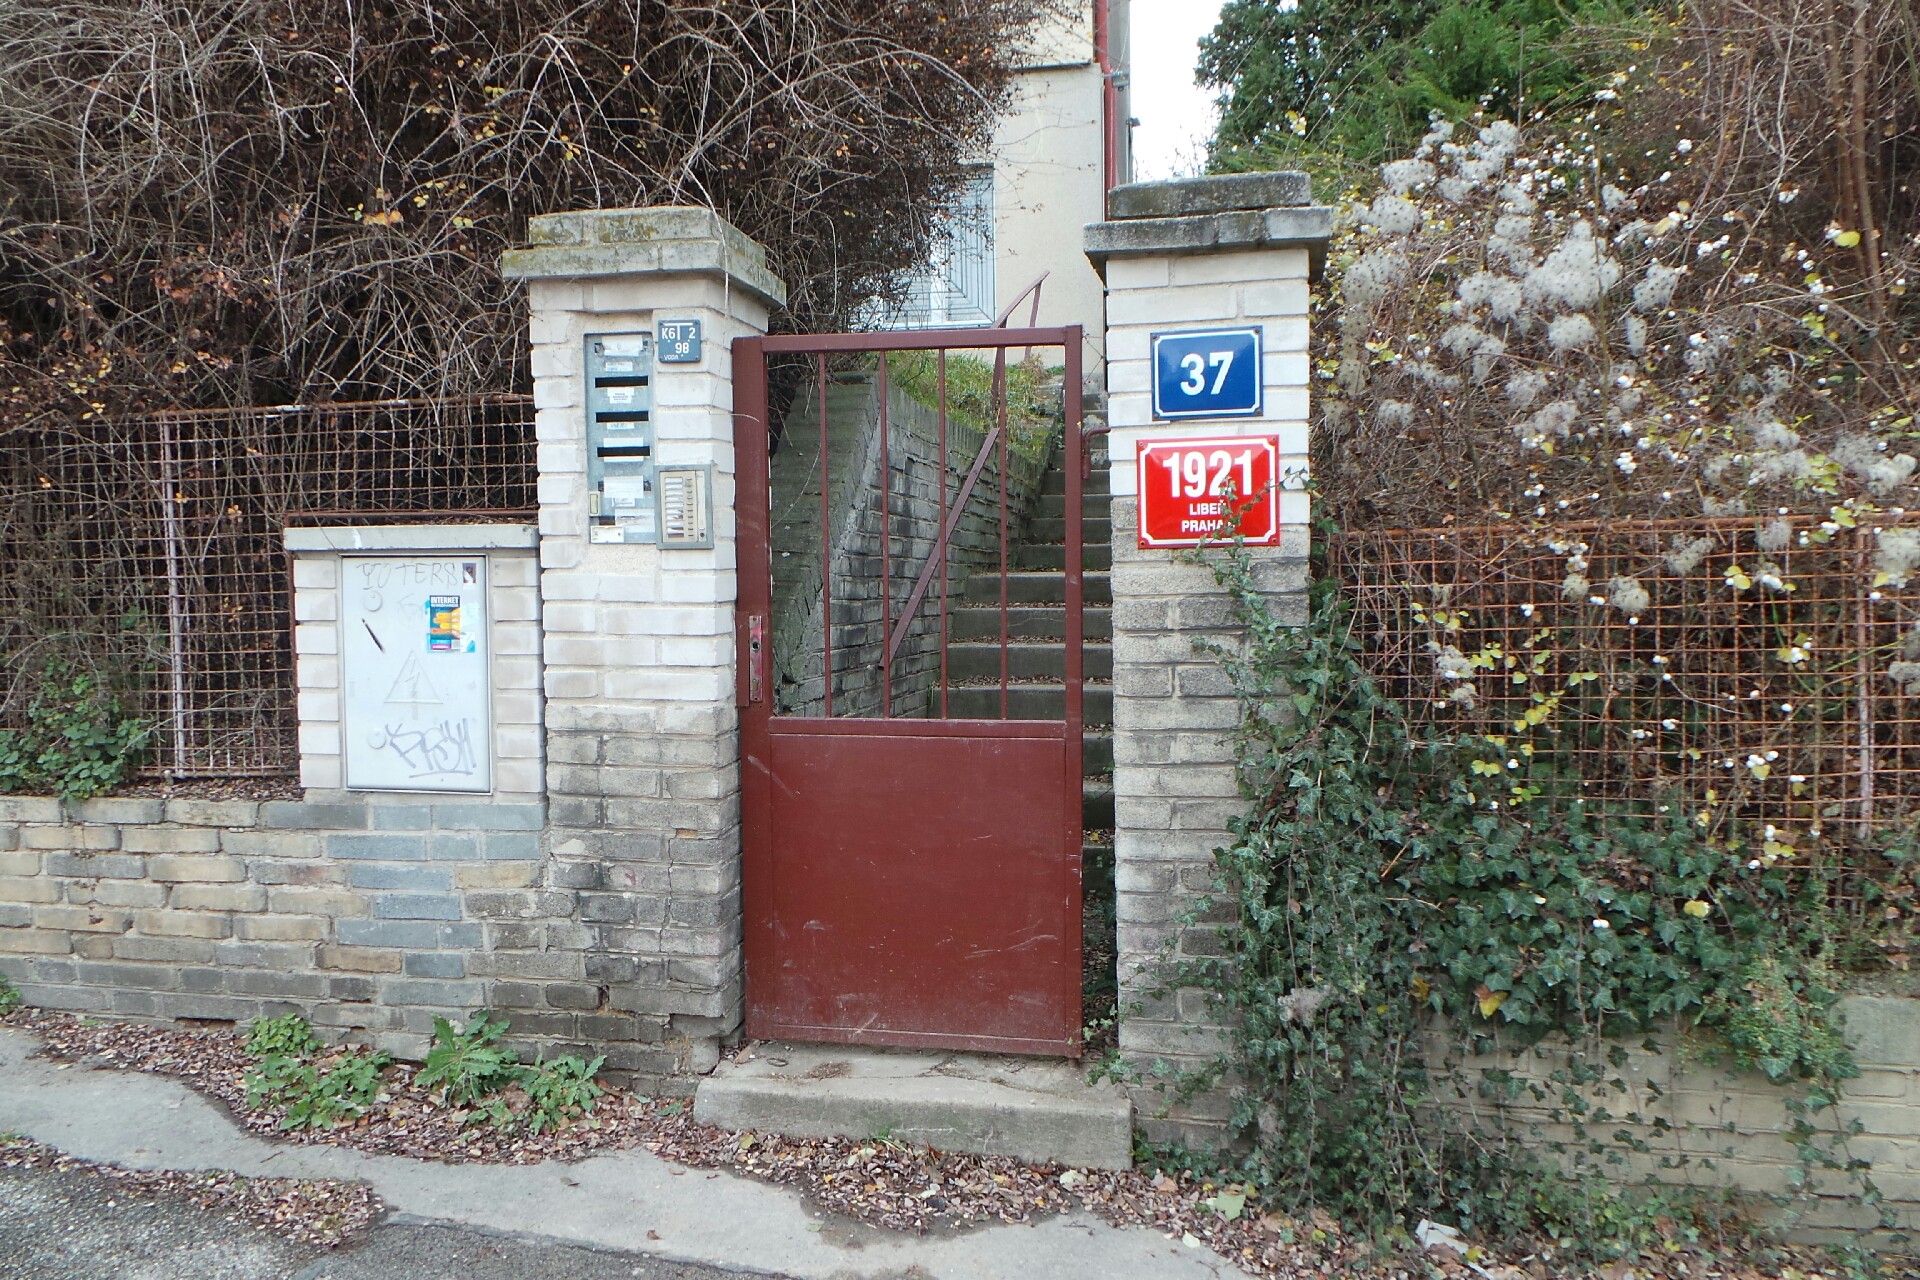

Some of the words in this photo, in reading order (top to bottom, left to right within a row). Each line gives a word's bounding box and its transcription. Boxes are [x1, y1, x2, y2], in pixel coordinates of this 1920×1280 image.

[688, 327, 696, 339] 2
[1180, 351, 1234, 396] 37
[1162, 449, 1253, 498] 1921
[430, 596, 459, 604] INTERNET
